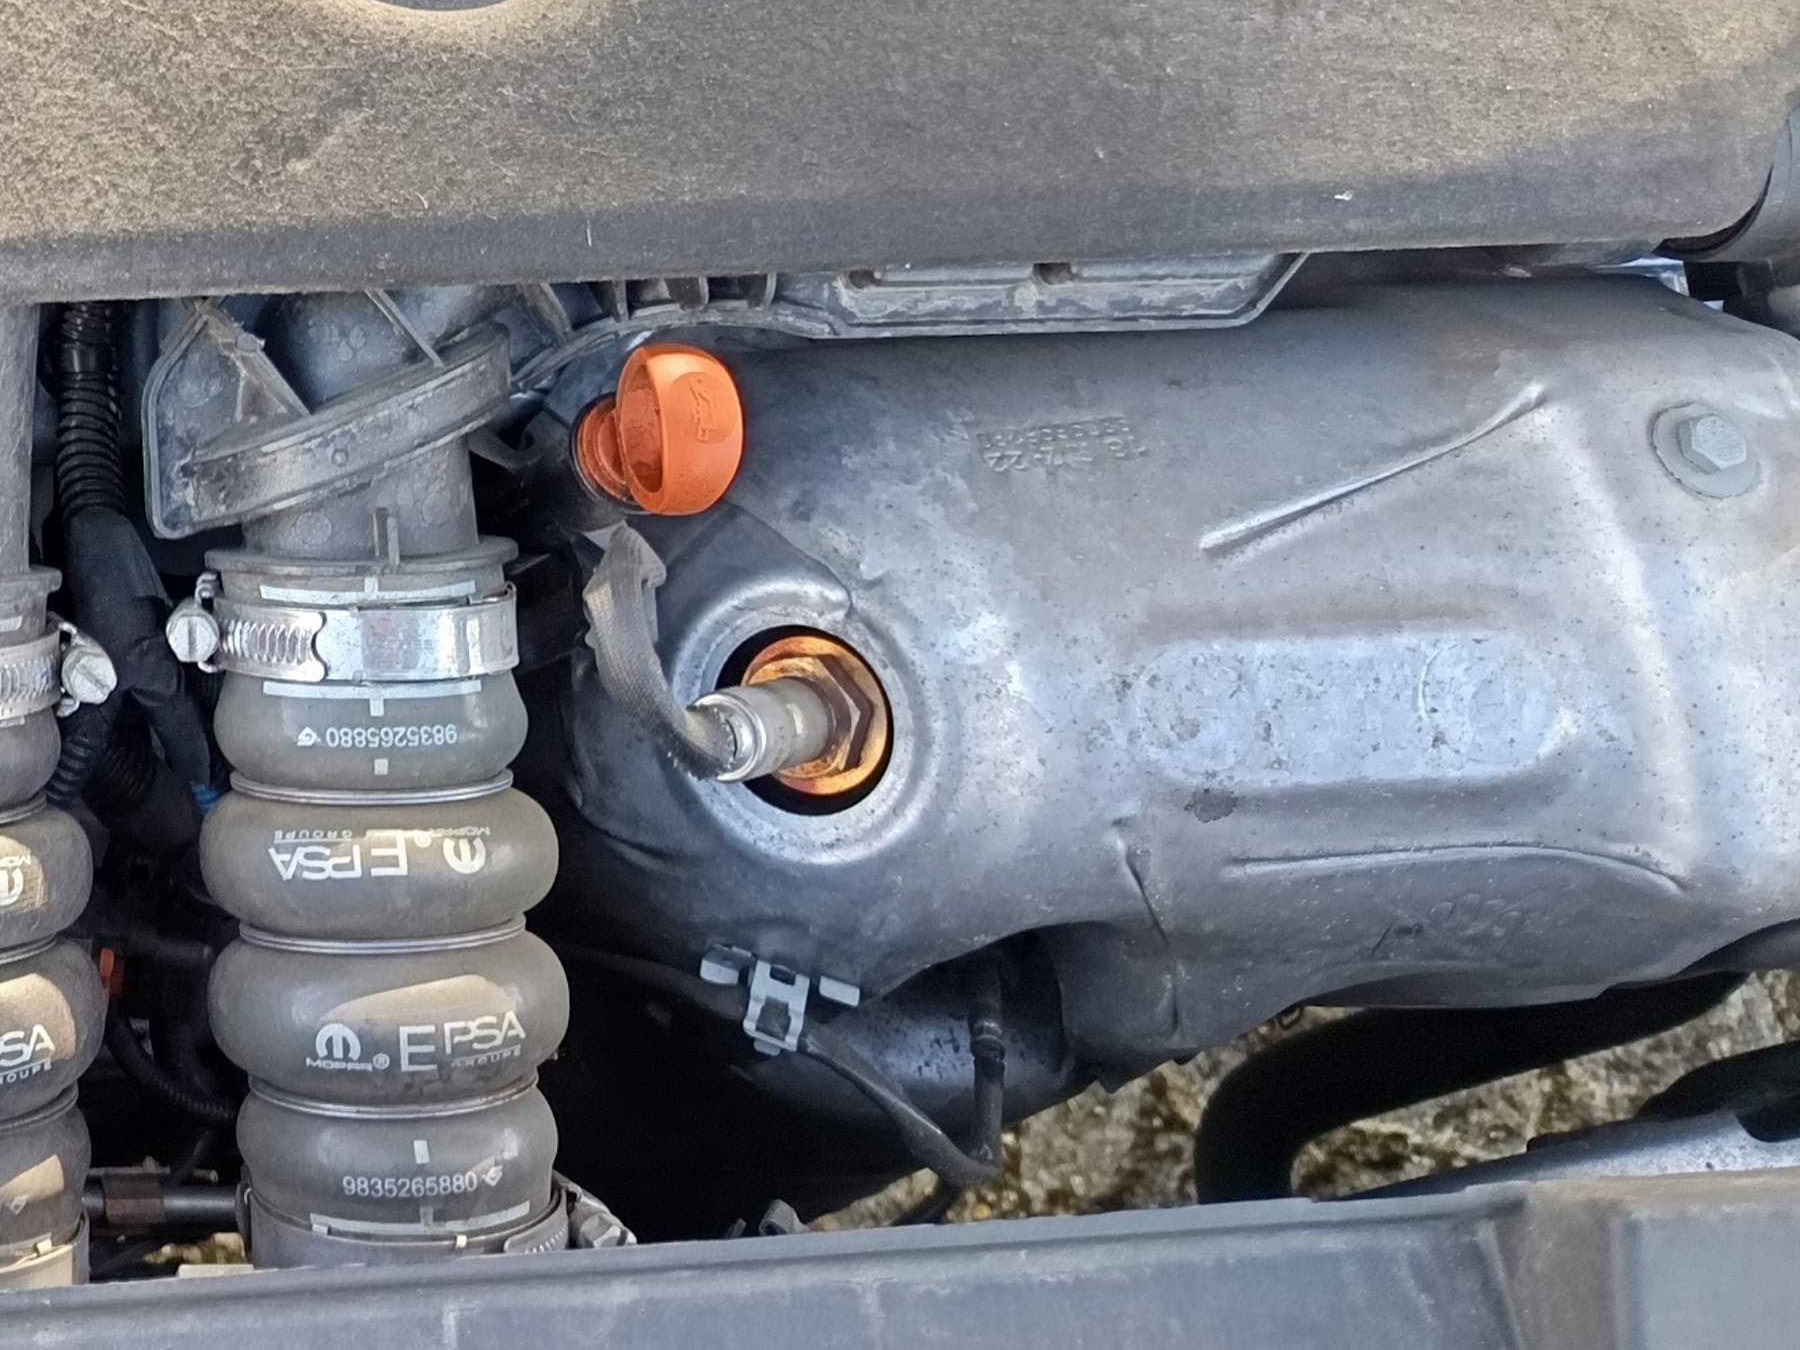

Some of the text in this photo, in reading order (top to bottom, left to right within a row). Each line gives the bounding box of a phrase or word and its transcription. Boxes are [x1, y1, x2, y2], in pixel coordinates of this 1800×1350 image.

[325, 724, 458, 748] 9835265880
[399, 1010, 527, 1072] E PSA
[305, 1057, 373, 1072] MOPAR
[342, 1171, 478, 1198] 9835265880
